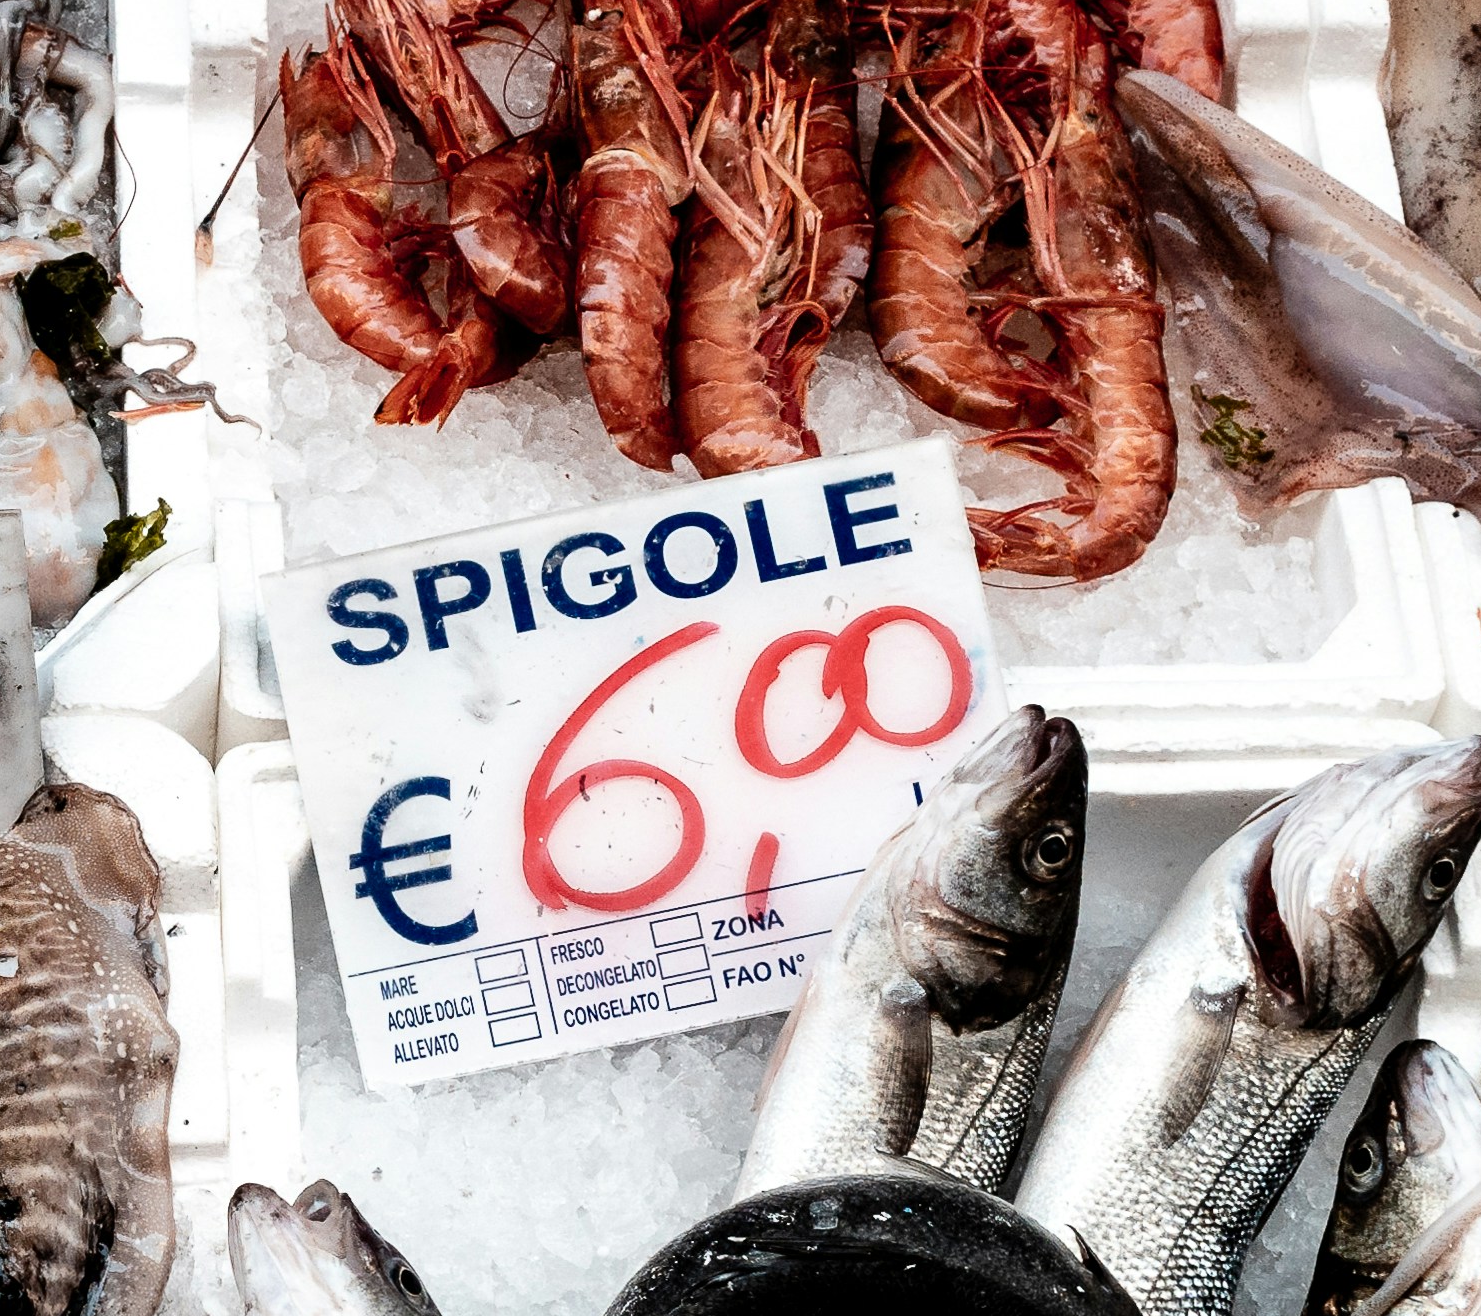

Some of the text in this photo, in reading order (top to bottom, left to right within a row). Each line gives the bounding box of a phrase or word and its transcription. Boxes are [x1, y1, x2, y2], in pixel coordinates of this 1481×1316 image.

[326, 470, 913, 666] SPIGOLE
[349, 776, 479, 946] €
[711, 909, 784, 941] ZONA
[551, 937, 604, 965] FRESCO
[380, 975, 418, 1001] MARE
[557, 959, 656, 996] DECONGELATO
[723, 961, 771, 989] FAO
[388, 996, 475, 1031] ACQUE DOLCI
[563, 992, 660, 1028] CONGELATO
[394, 1033, 459, 1064] ALLEVATO
